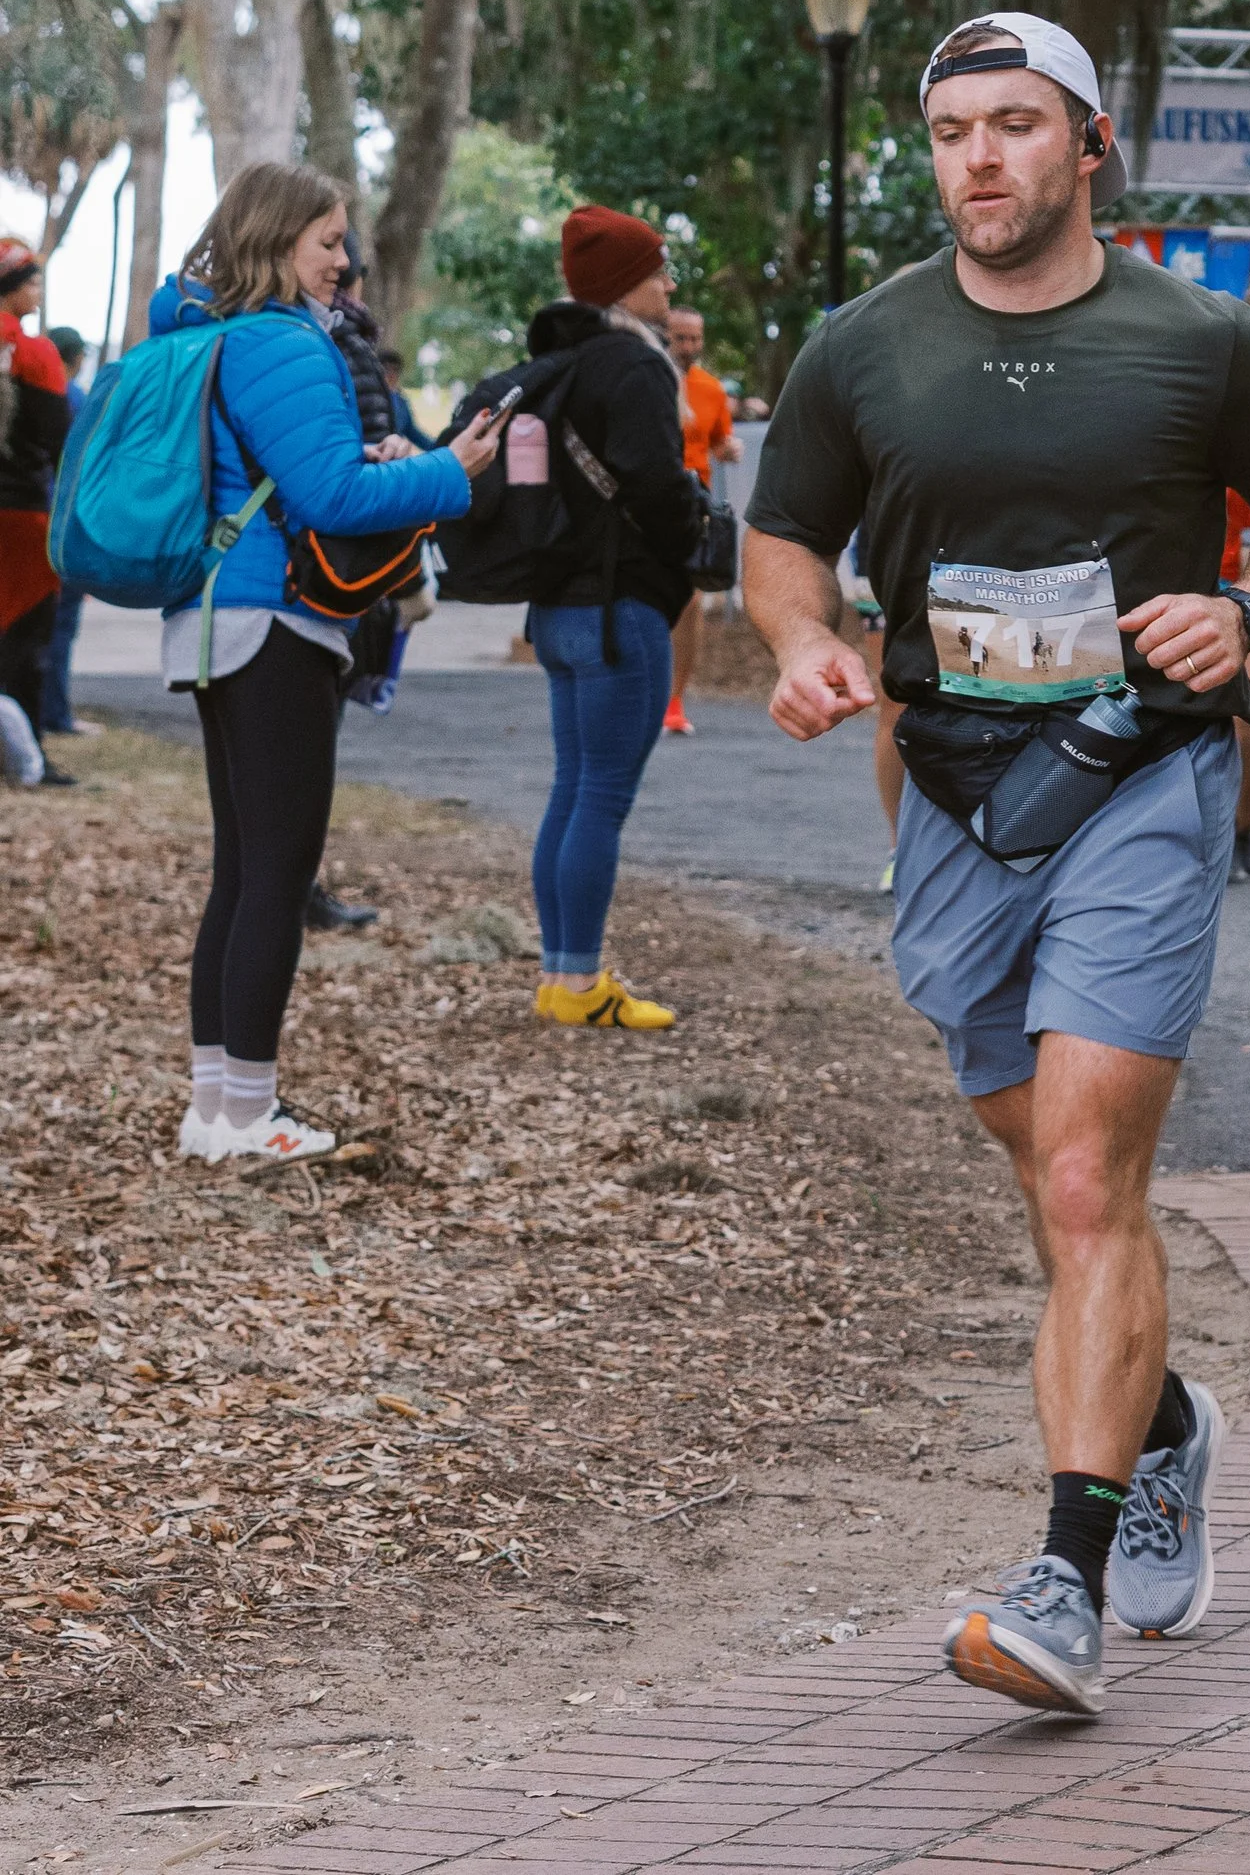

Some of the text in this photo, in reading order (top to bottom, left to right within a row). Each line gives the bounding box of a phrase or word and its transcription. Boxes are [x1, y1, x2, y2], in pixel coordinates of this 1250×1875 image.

[983, 361, 1055, 373] HYROX
[945, 567, 1090, 589] DAUFUSKIE ISLAND
[975, 587, 1060, 605] MARATHON
[955, 612, 1086, 669] 717
[1060, 739, 1111, 768] SALOMON
